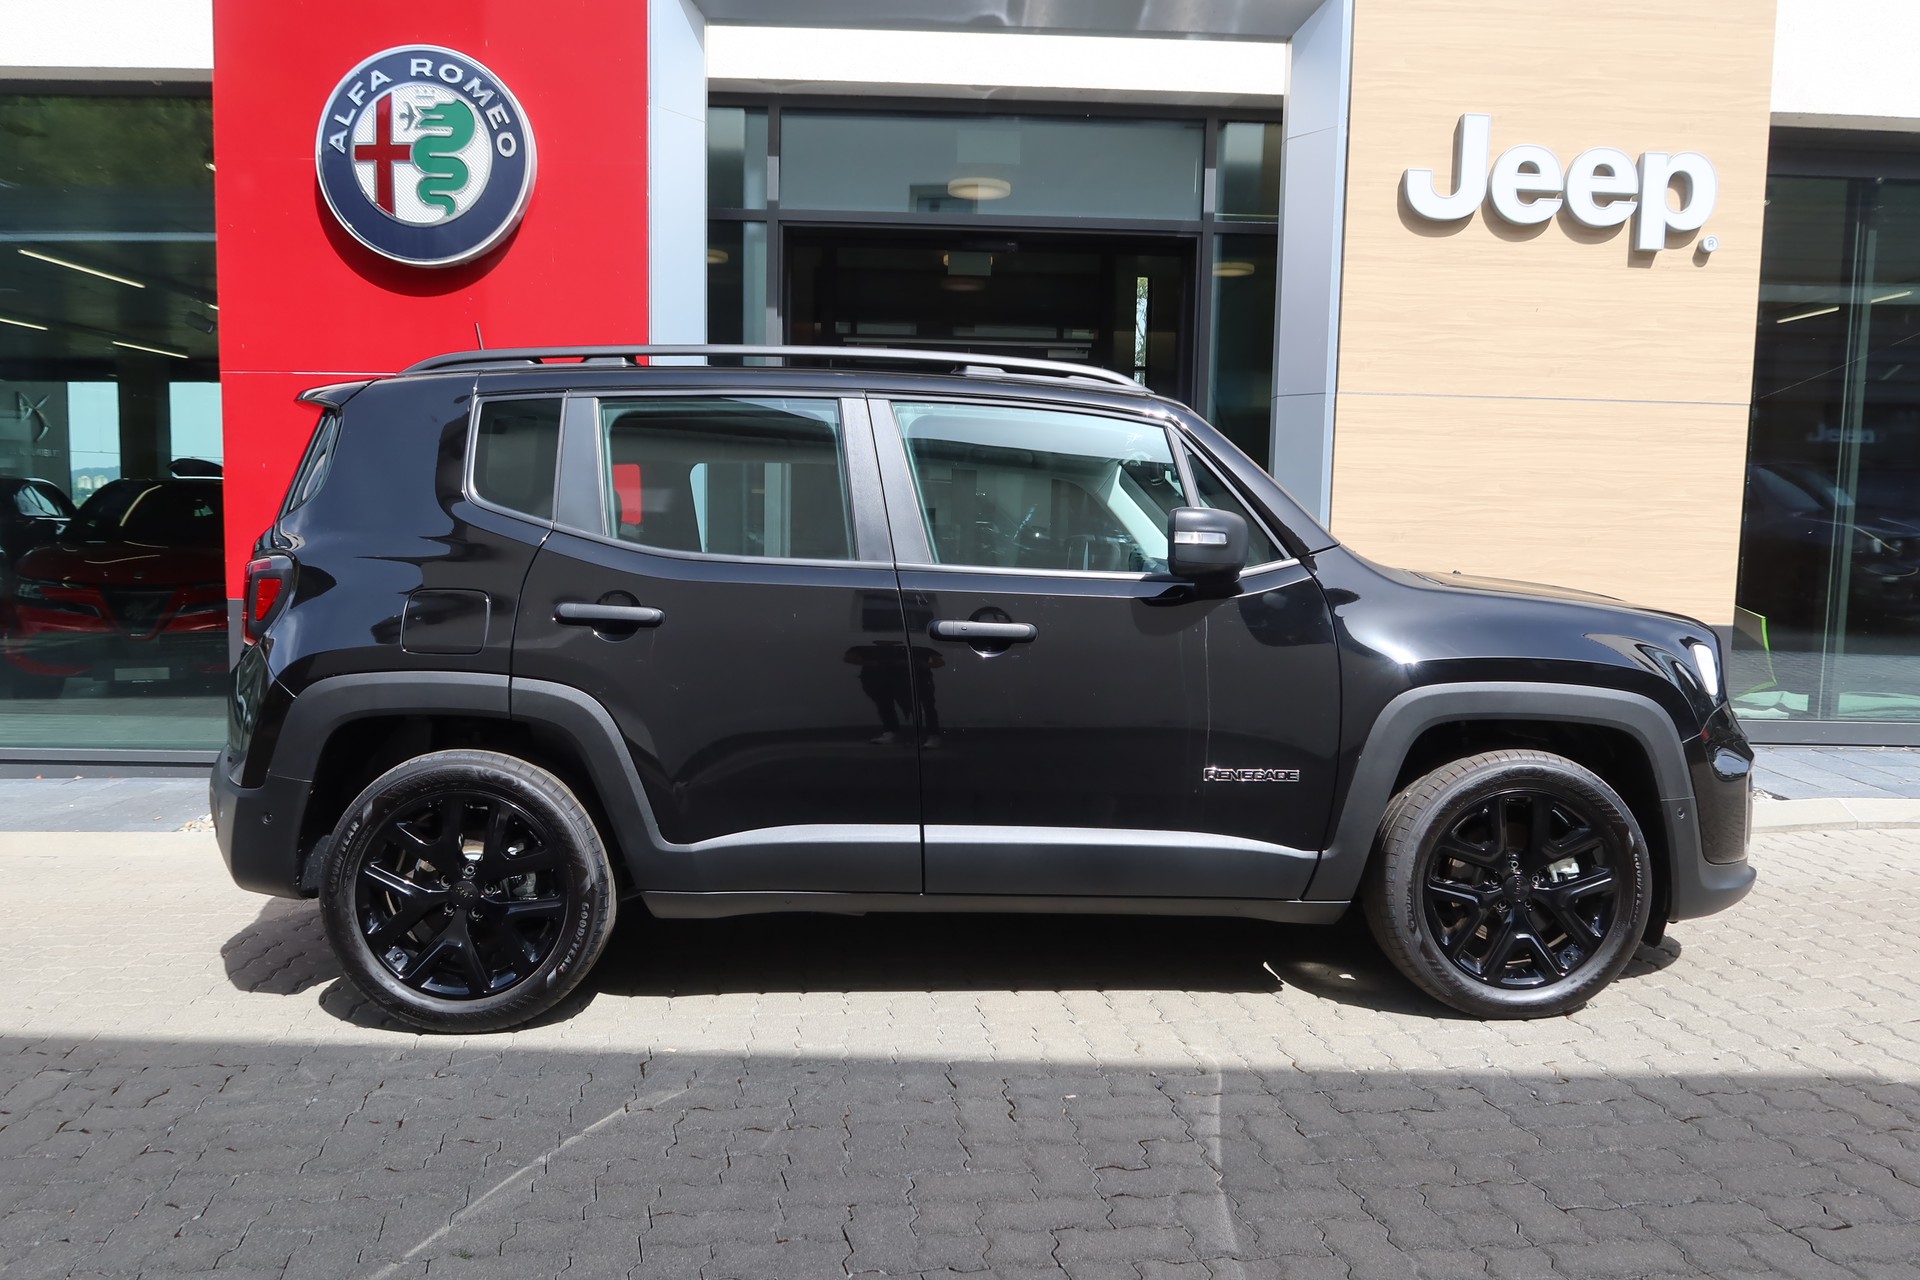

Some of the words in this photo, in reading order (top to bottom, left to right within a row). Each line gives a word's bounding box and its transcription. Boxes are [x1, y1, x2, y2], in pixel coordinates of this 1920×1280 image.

[328, 68, 393, 155] ALFA
[410, 58, 518, 158] ROMEO
[1404, 112, 1718, 251] Jeep
[1203, 766, 1300, 782] RENEGADE
[557, 901, 590, 974] GOODYEAR
